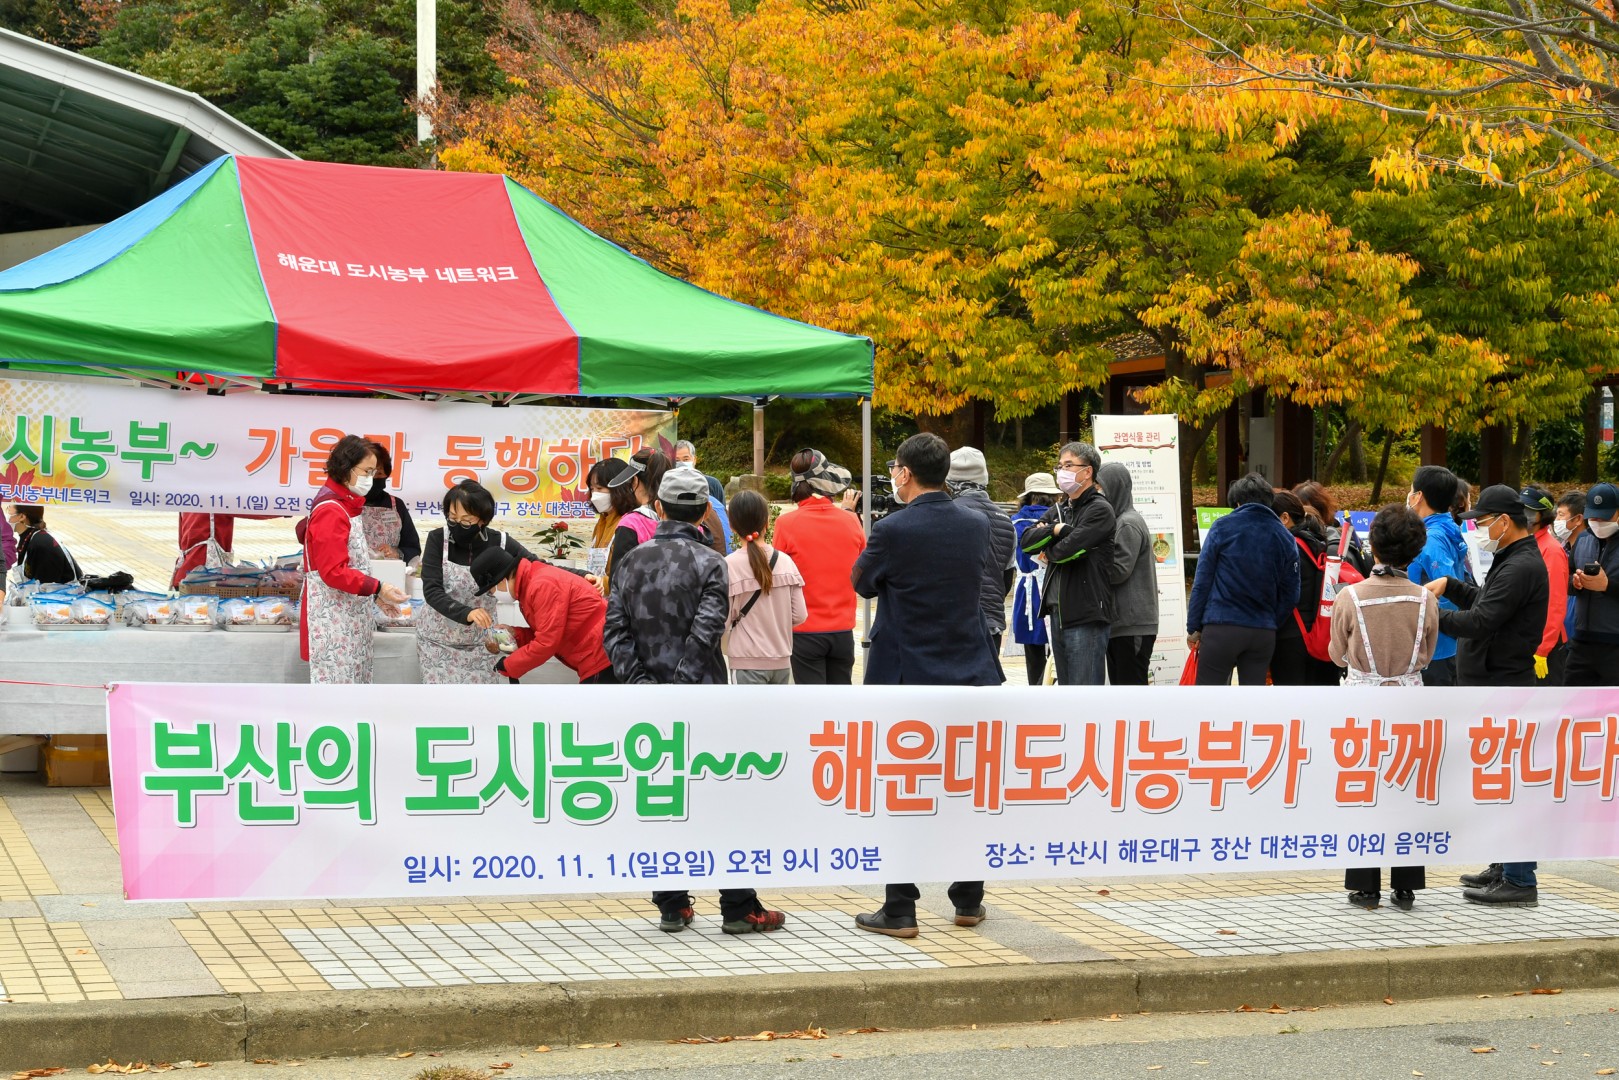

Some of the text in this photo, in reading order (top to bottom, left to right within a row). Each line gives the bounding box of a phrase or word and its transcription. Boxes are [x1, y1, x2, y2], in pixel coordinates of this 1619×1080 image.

[277, 253, 519, 284] 해운대 도시농부 네트워크
[1113, 432, 1161, 443] 관엽식물 관리
[129, 491, 160, 507] 일시:
[165, 493, 203, 507] 2020.
[209, 495, 229, 509] 11.
[235, 495, 269, 511] 1.(일)
[273, 496, 300, 511] 오전
[516, 502, 542, 516] 장산
[144, 716, 1619, 825] 부산의 도시농업~~ 해운대도시농부가 함께 합니다
[403, 846, 882, 884] 일시: 2020. 11. 1.(일요일) 오전 9시 30분
[985, 831, 1451, 869] 장소: 부산시 해운대구 장산 대천공원 야외 음악당
